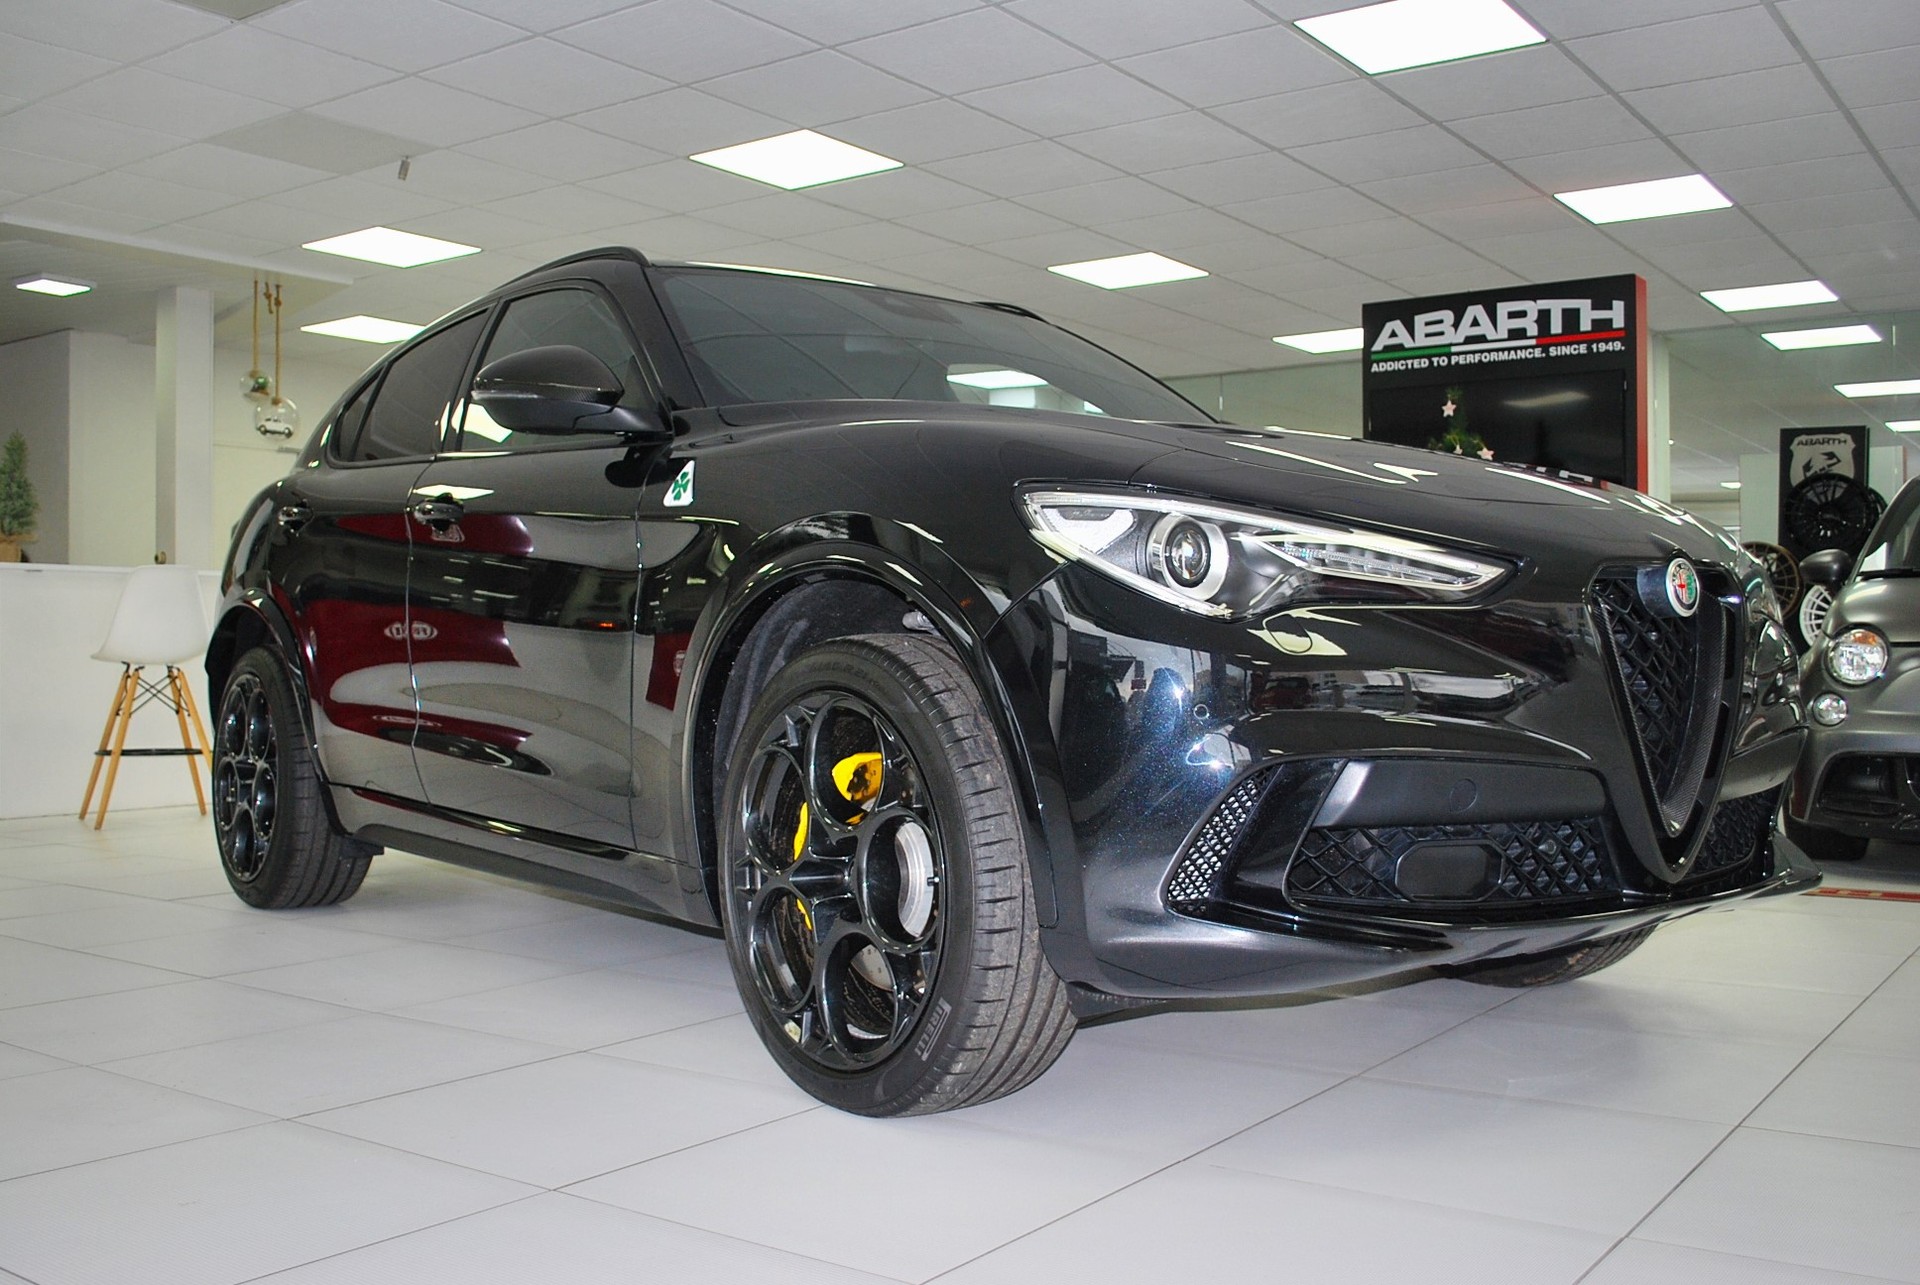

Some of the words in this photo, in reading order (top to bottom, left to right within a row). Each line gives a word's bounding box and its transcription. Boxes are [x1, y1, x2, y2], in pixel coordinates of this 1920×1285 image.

[1371, 299, 1625, 352] ABARTH
[1371, 358, 1430, 373] ADDICTED
[1432, 355, 1449, 368] TO
[1451, 348, 1546, 365] PERFORMANCE.
[1549, 343, 1588, 357] SINCE
[1591, 341, 1625, 353] 1949.
[1797, 437, 1847, 447] ABARTH
[914, 997, 952, 1061] PIRELLI
